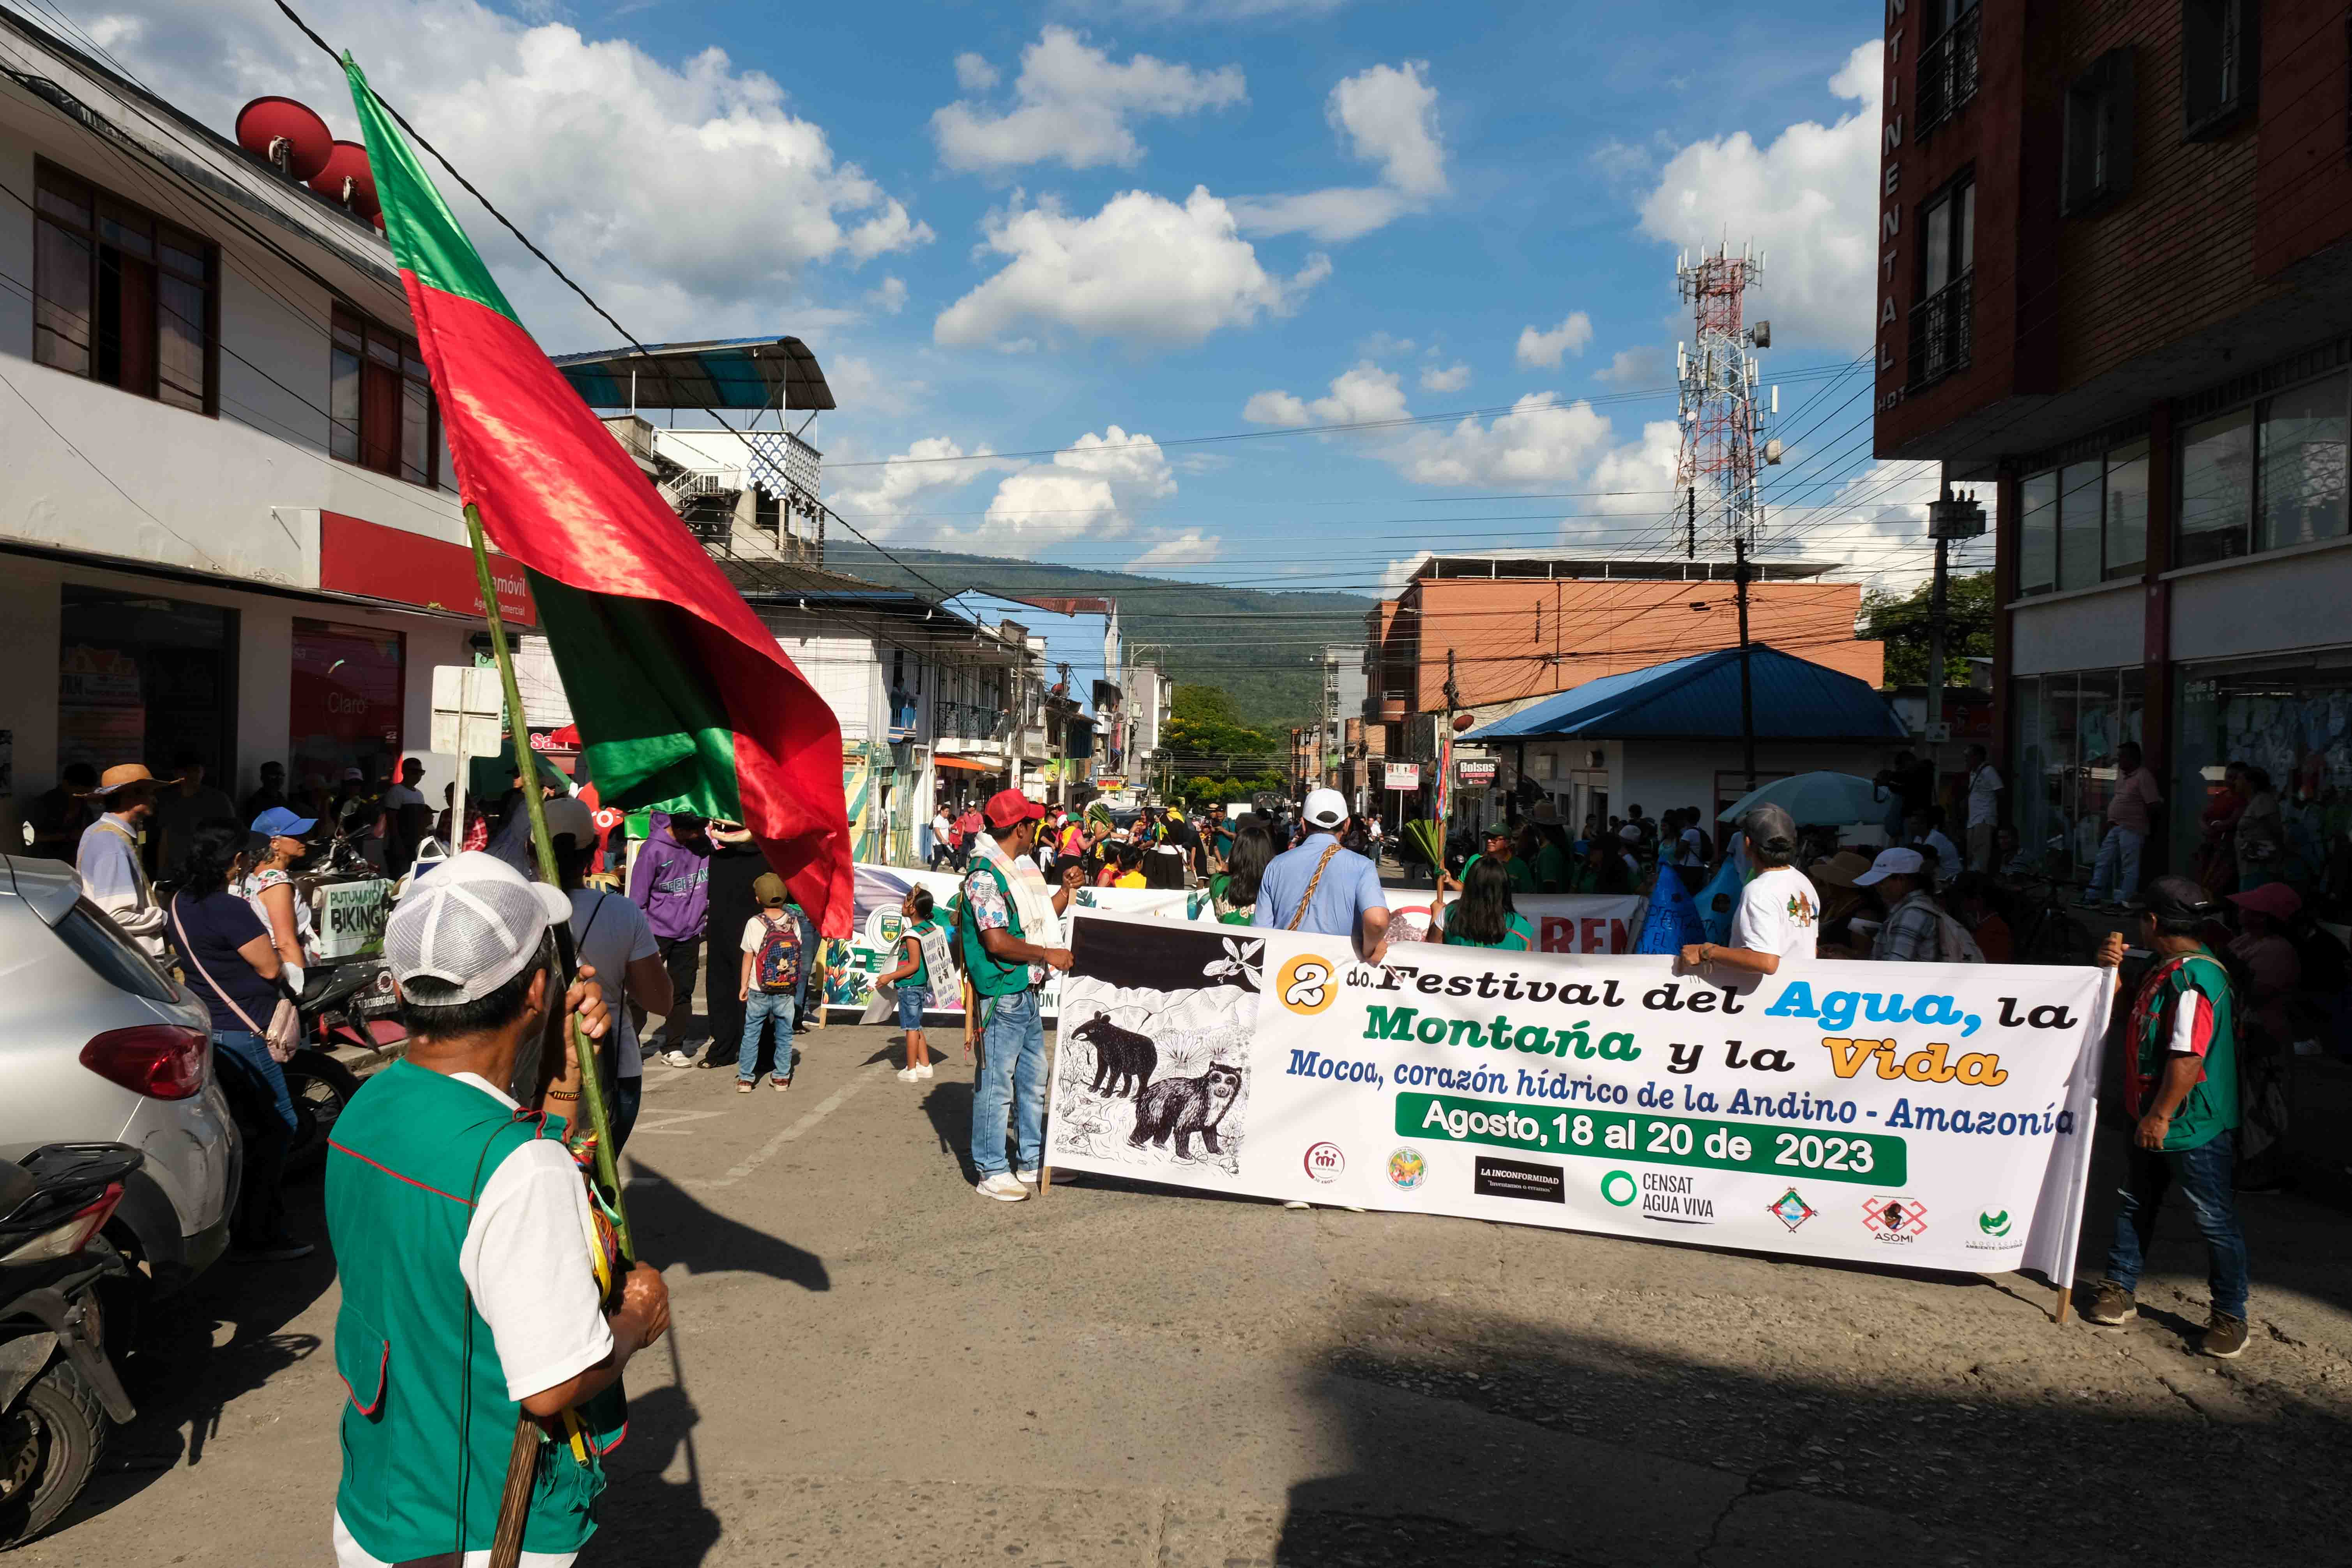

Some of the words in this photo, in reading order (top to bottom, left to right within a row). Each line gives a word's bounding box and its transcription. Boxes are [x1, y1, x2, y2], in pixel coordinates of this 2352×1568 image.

[1460, 762, 1495, 773] Bolsos
[330, 889, 380, 906] PUTUMAYO
[331, 904, 380, 934] BIKING
[1285, 963, 1328, 1007] 2
[1347, 967, 1373, 988] do.
[1376, 965, 1624, 1007] Festival
[1642, 982, 1744, 1015] del
[1765, 981, 1982, 1037] Agua,
[1999, 998, 2078, 1029] la
[1668, 1041, 1704, 1074] y
[1725, 1041, 1795, 1072] la
[1822, 1037, 2009, 1087] Vida
[1286, 1049, 1384, 1091] Mocoa,
[1394, 1064, 1507, 1094] corazón
[1516, 1069, 1628, 1104] hídrico
[1638, 1080, 1673, 1110] de
[1684, 1085, 1718, 1113] la
[1727, 1089, 1857, 1123] Andino
[1885, 1099, 2074, 1136] Amazonía
[1605, 1119, 1635, 1150] al
[1646, 1122, 1694, 1156] 20
[1704, 1130, 1752, 1161] de
[1775, 1137, 1875, 1173] 2023
[1492, 1170, 1559, 1185] INCONFORMIDAD
[1643, 1173, 1693, 1194] CENSAT
[1643, 1194, 1680, 1214] AGUA
[1684, 1198, 1714, 1217] VIVA
[1874, 1233, 1913, 1243] ASOMI
